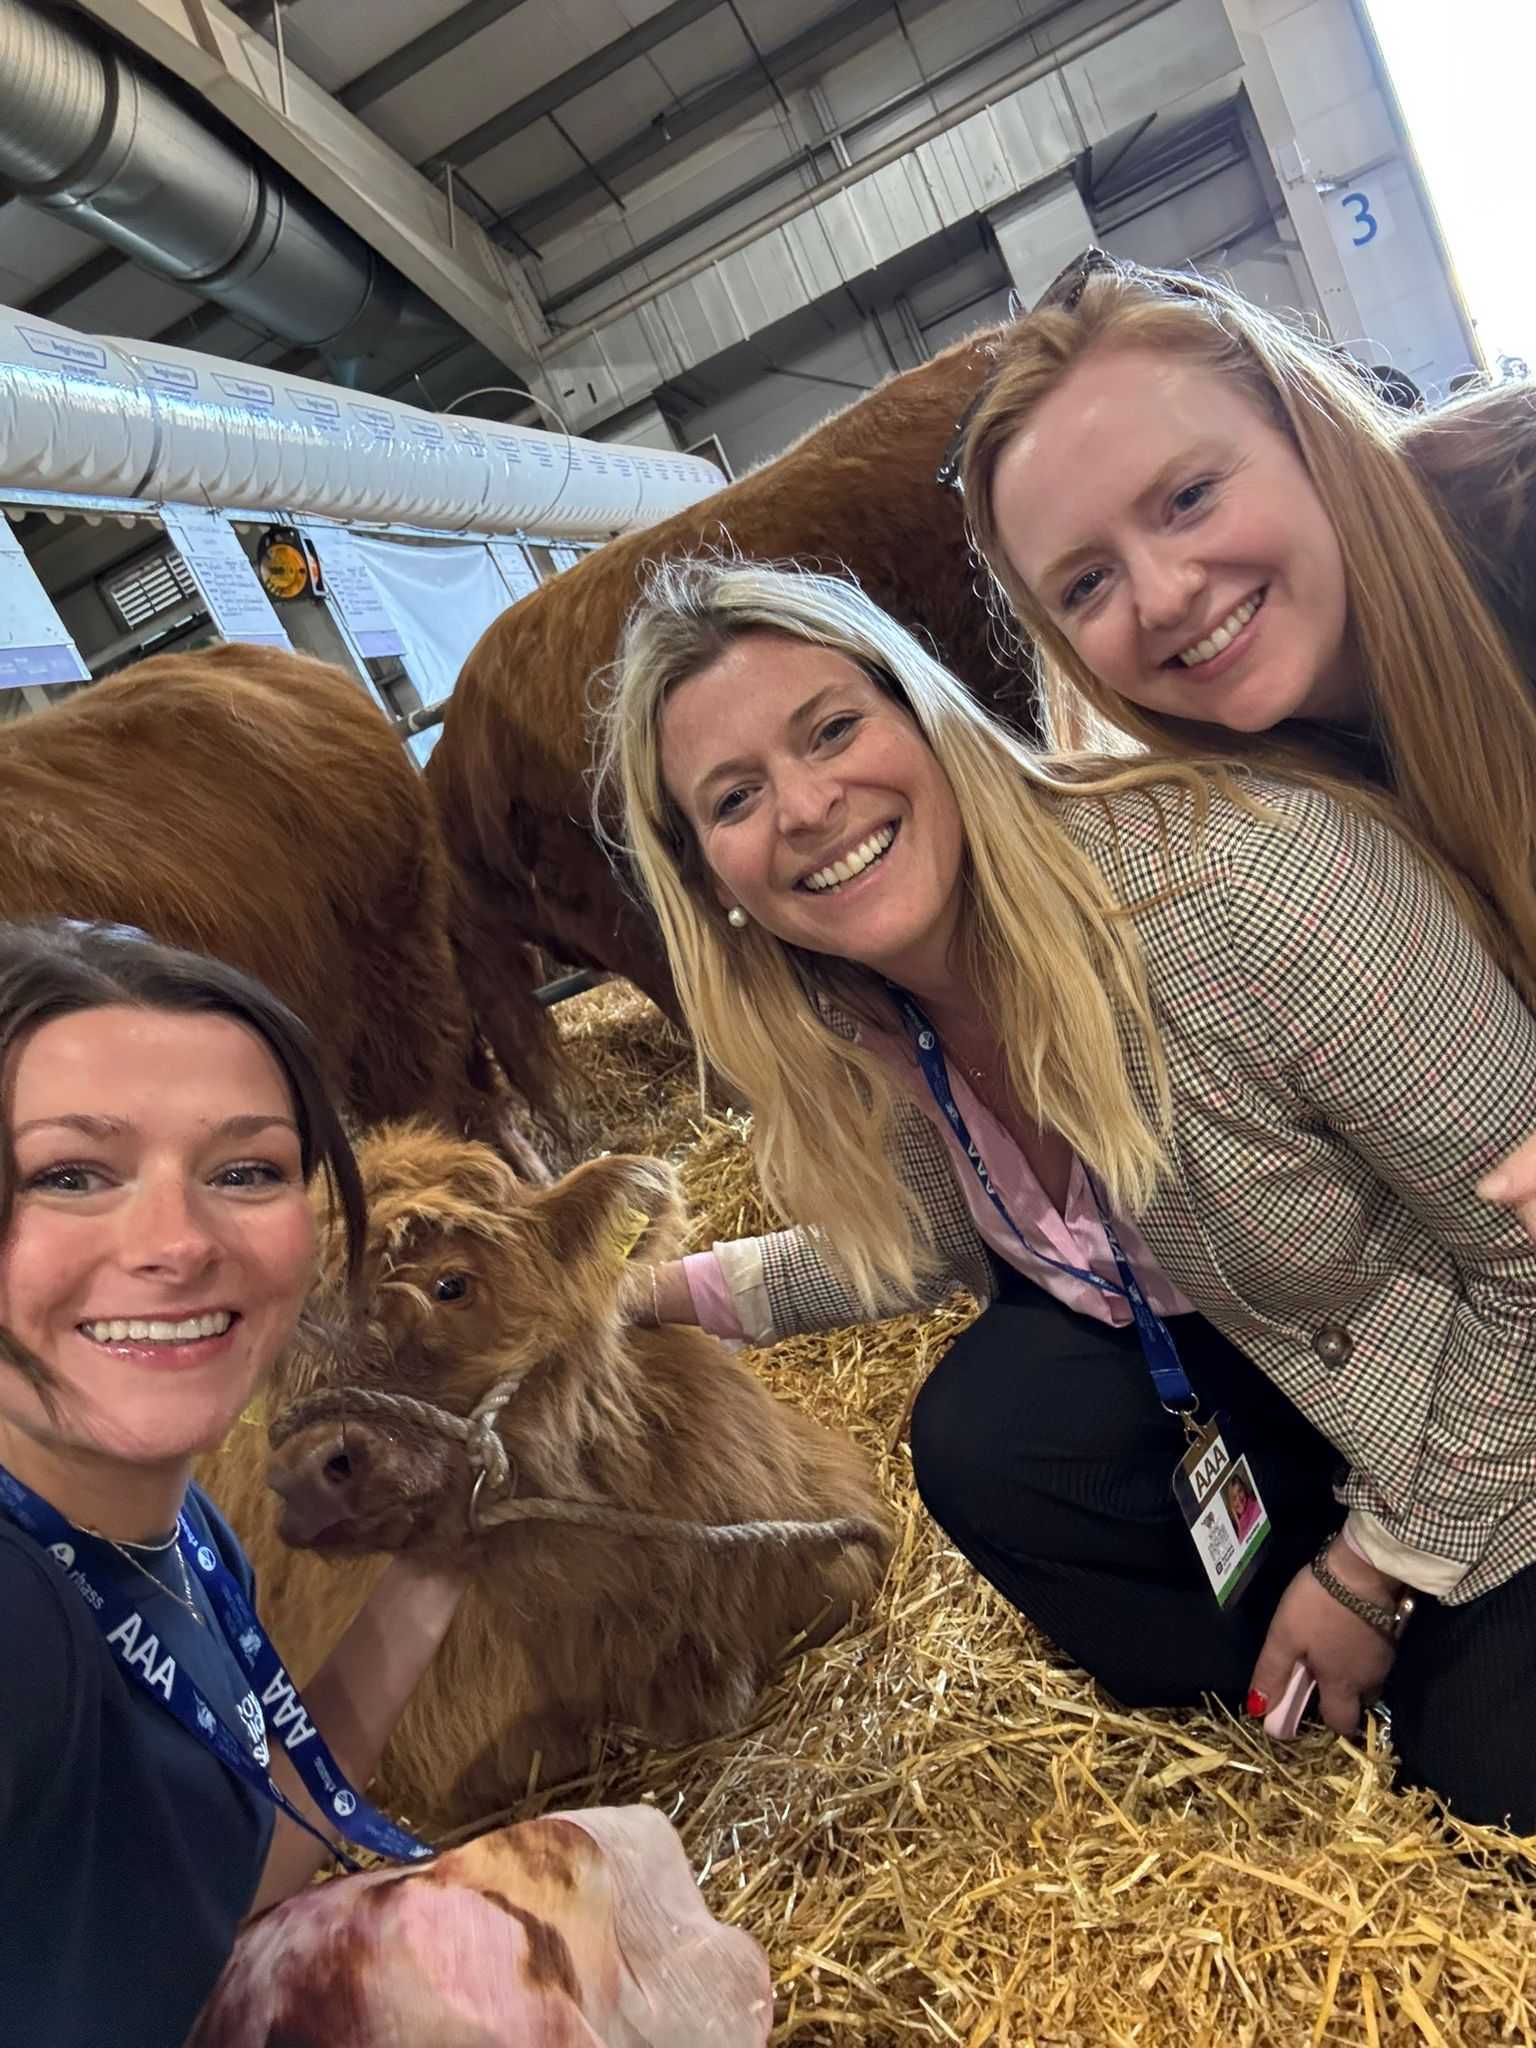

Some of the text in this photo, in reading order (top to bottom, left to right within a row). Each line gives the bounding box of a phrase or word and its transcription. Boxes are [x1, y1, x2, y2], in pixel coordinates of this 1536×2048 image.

[1342, 193, 1377, 246] 3
[1195, 1445, 1226, 1497] AAA
[106, 1612, 176, 1700] AAA
[262, 1667, 317, 1749] AAA
